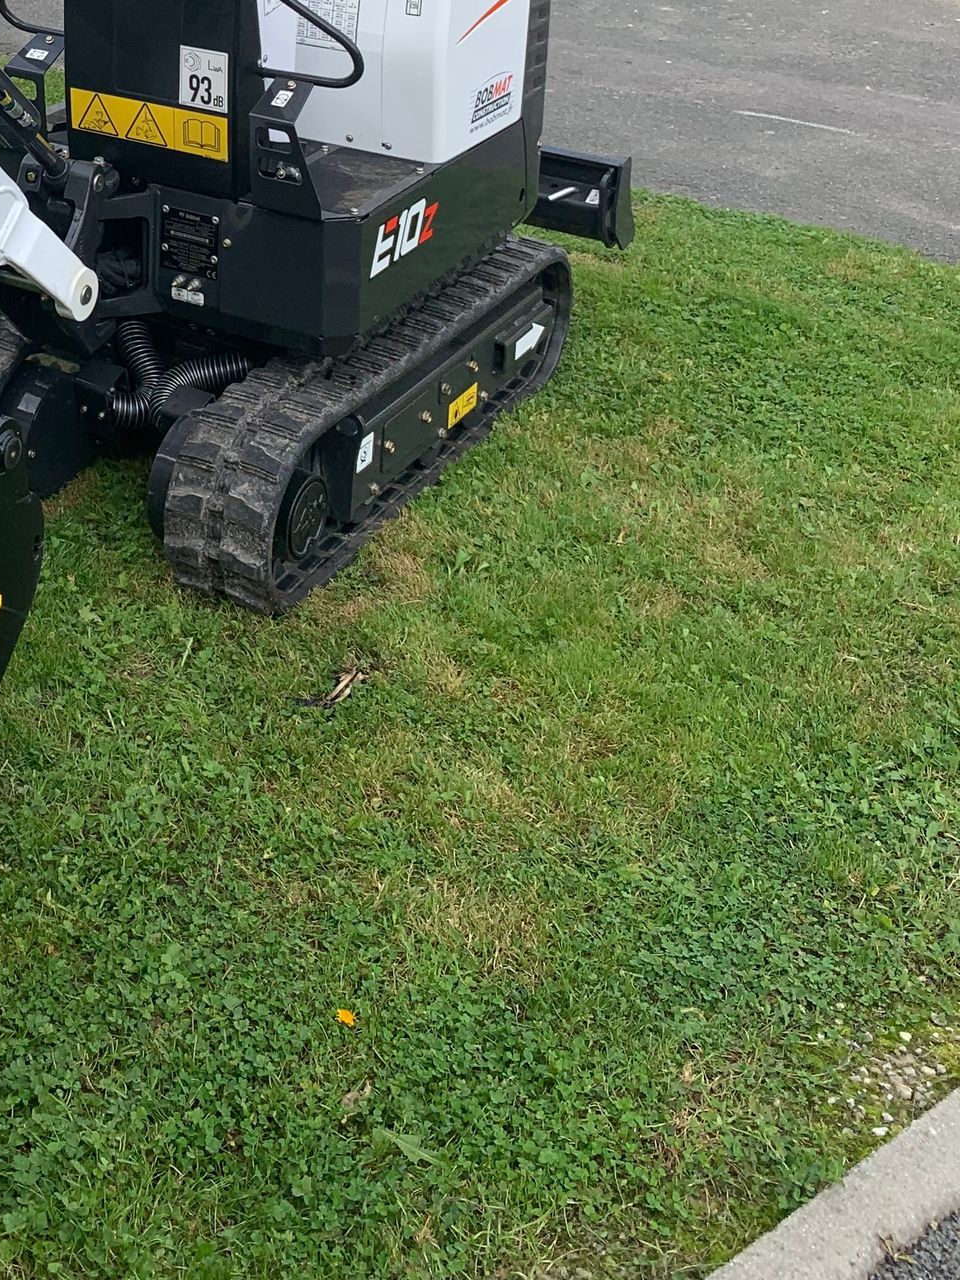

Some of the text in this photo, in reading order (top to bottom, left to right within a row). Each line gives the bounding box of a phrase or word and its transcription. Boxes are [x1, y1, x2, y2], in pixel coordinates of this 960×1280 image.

[189, 73, 224, 108] 93 dB
[474, 74, 513, 109] BOBMAT
